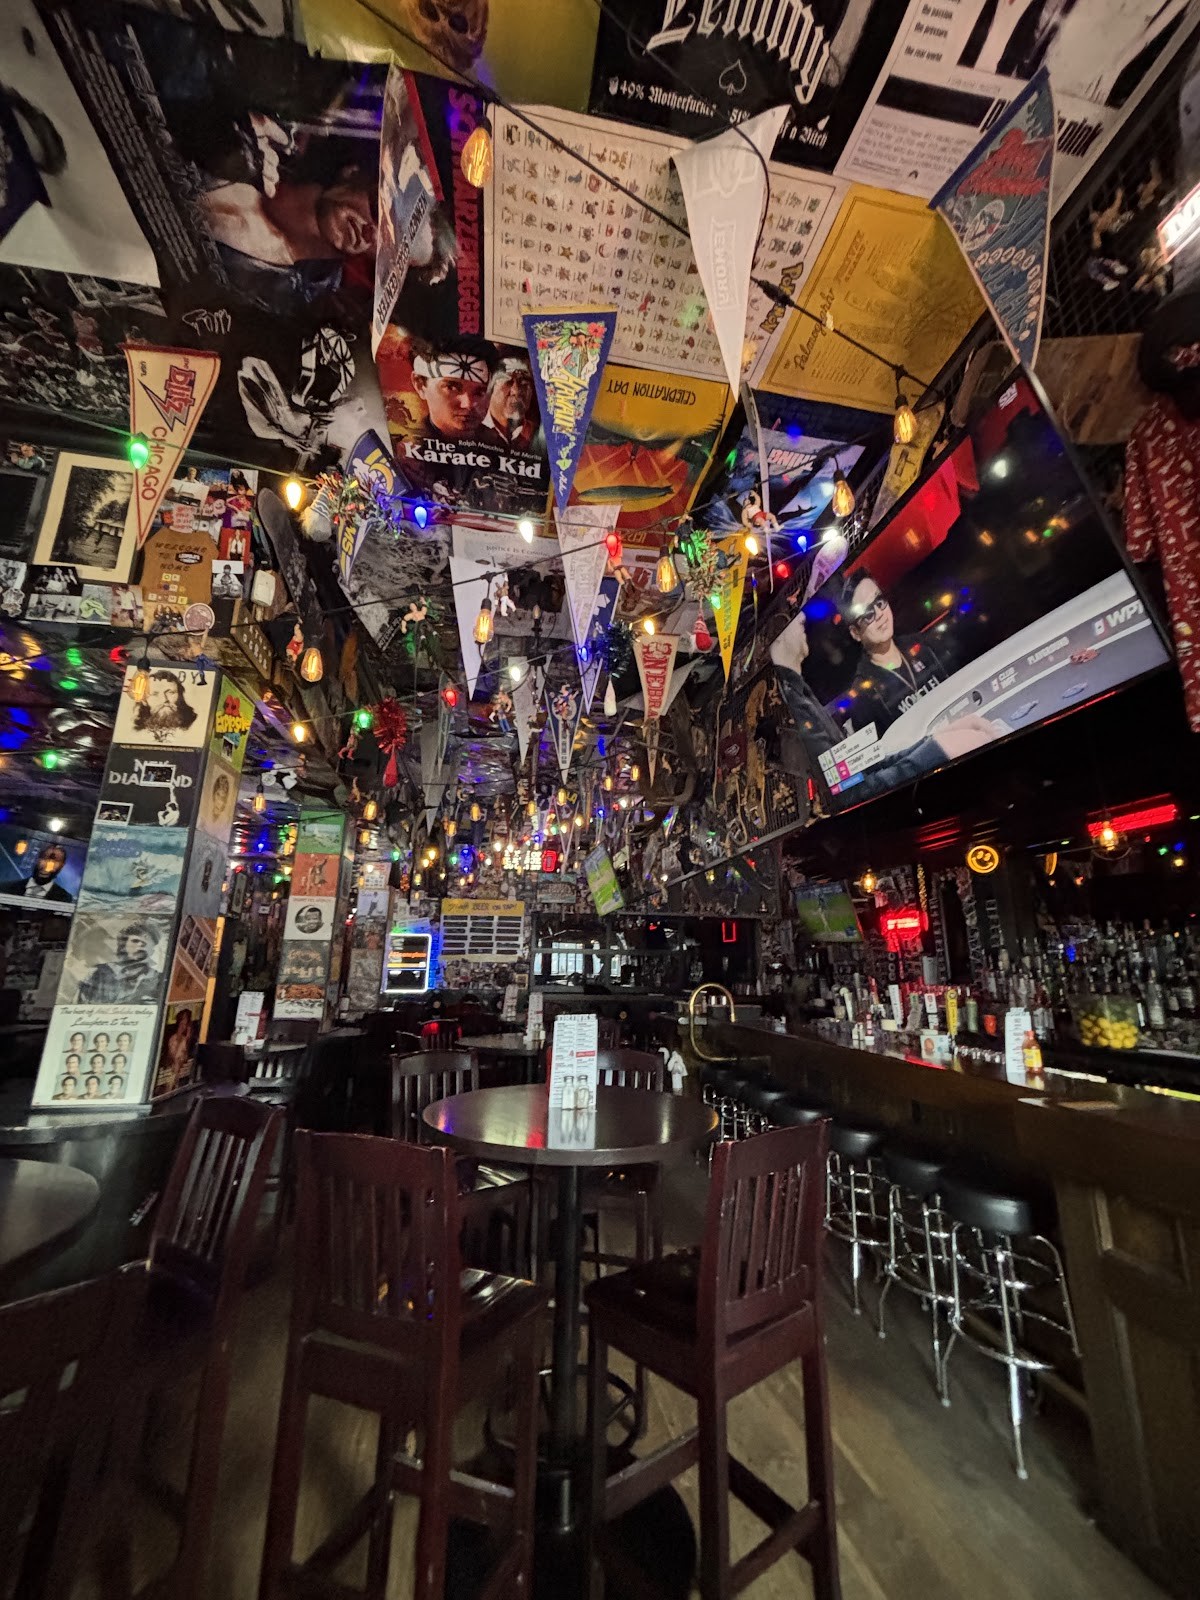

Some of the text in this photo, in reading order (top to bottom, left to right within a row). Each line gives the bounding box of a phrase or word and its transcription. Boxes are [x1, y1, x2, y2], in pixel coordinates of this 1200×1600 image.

[448, 86, 480, 335] SCARZENEGGER
[376, 271, 398, 324] CENTER
[793, 286, 836, 371] Palmogaph
[549, 367, 589, 435] HAWAII
[606, 379, 697, 406] CELEBRATION DAY
[141, 426, 168, 501] CHICAGO
[404, 442, 542, 479] Karate Kid
[424, 438, 456, 453] The
[458, 439, 543, 462] Ralph Macchio Pat Morita
[155, 541, 207, 554] WELCOME
[642, 653, 671, 721] NEBRA
[108, 769, 193, 790] DIAND
